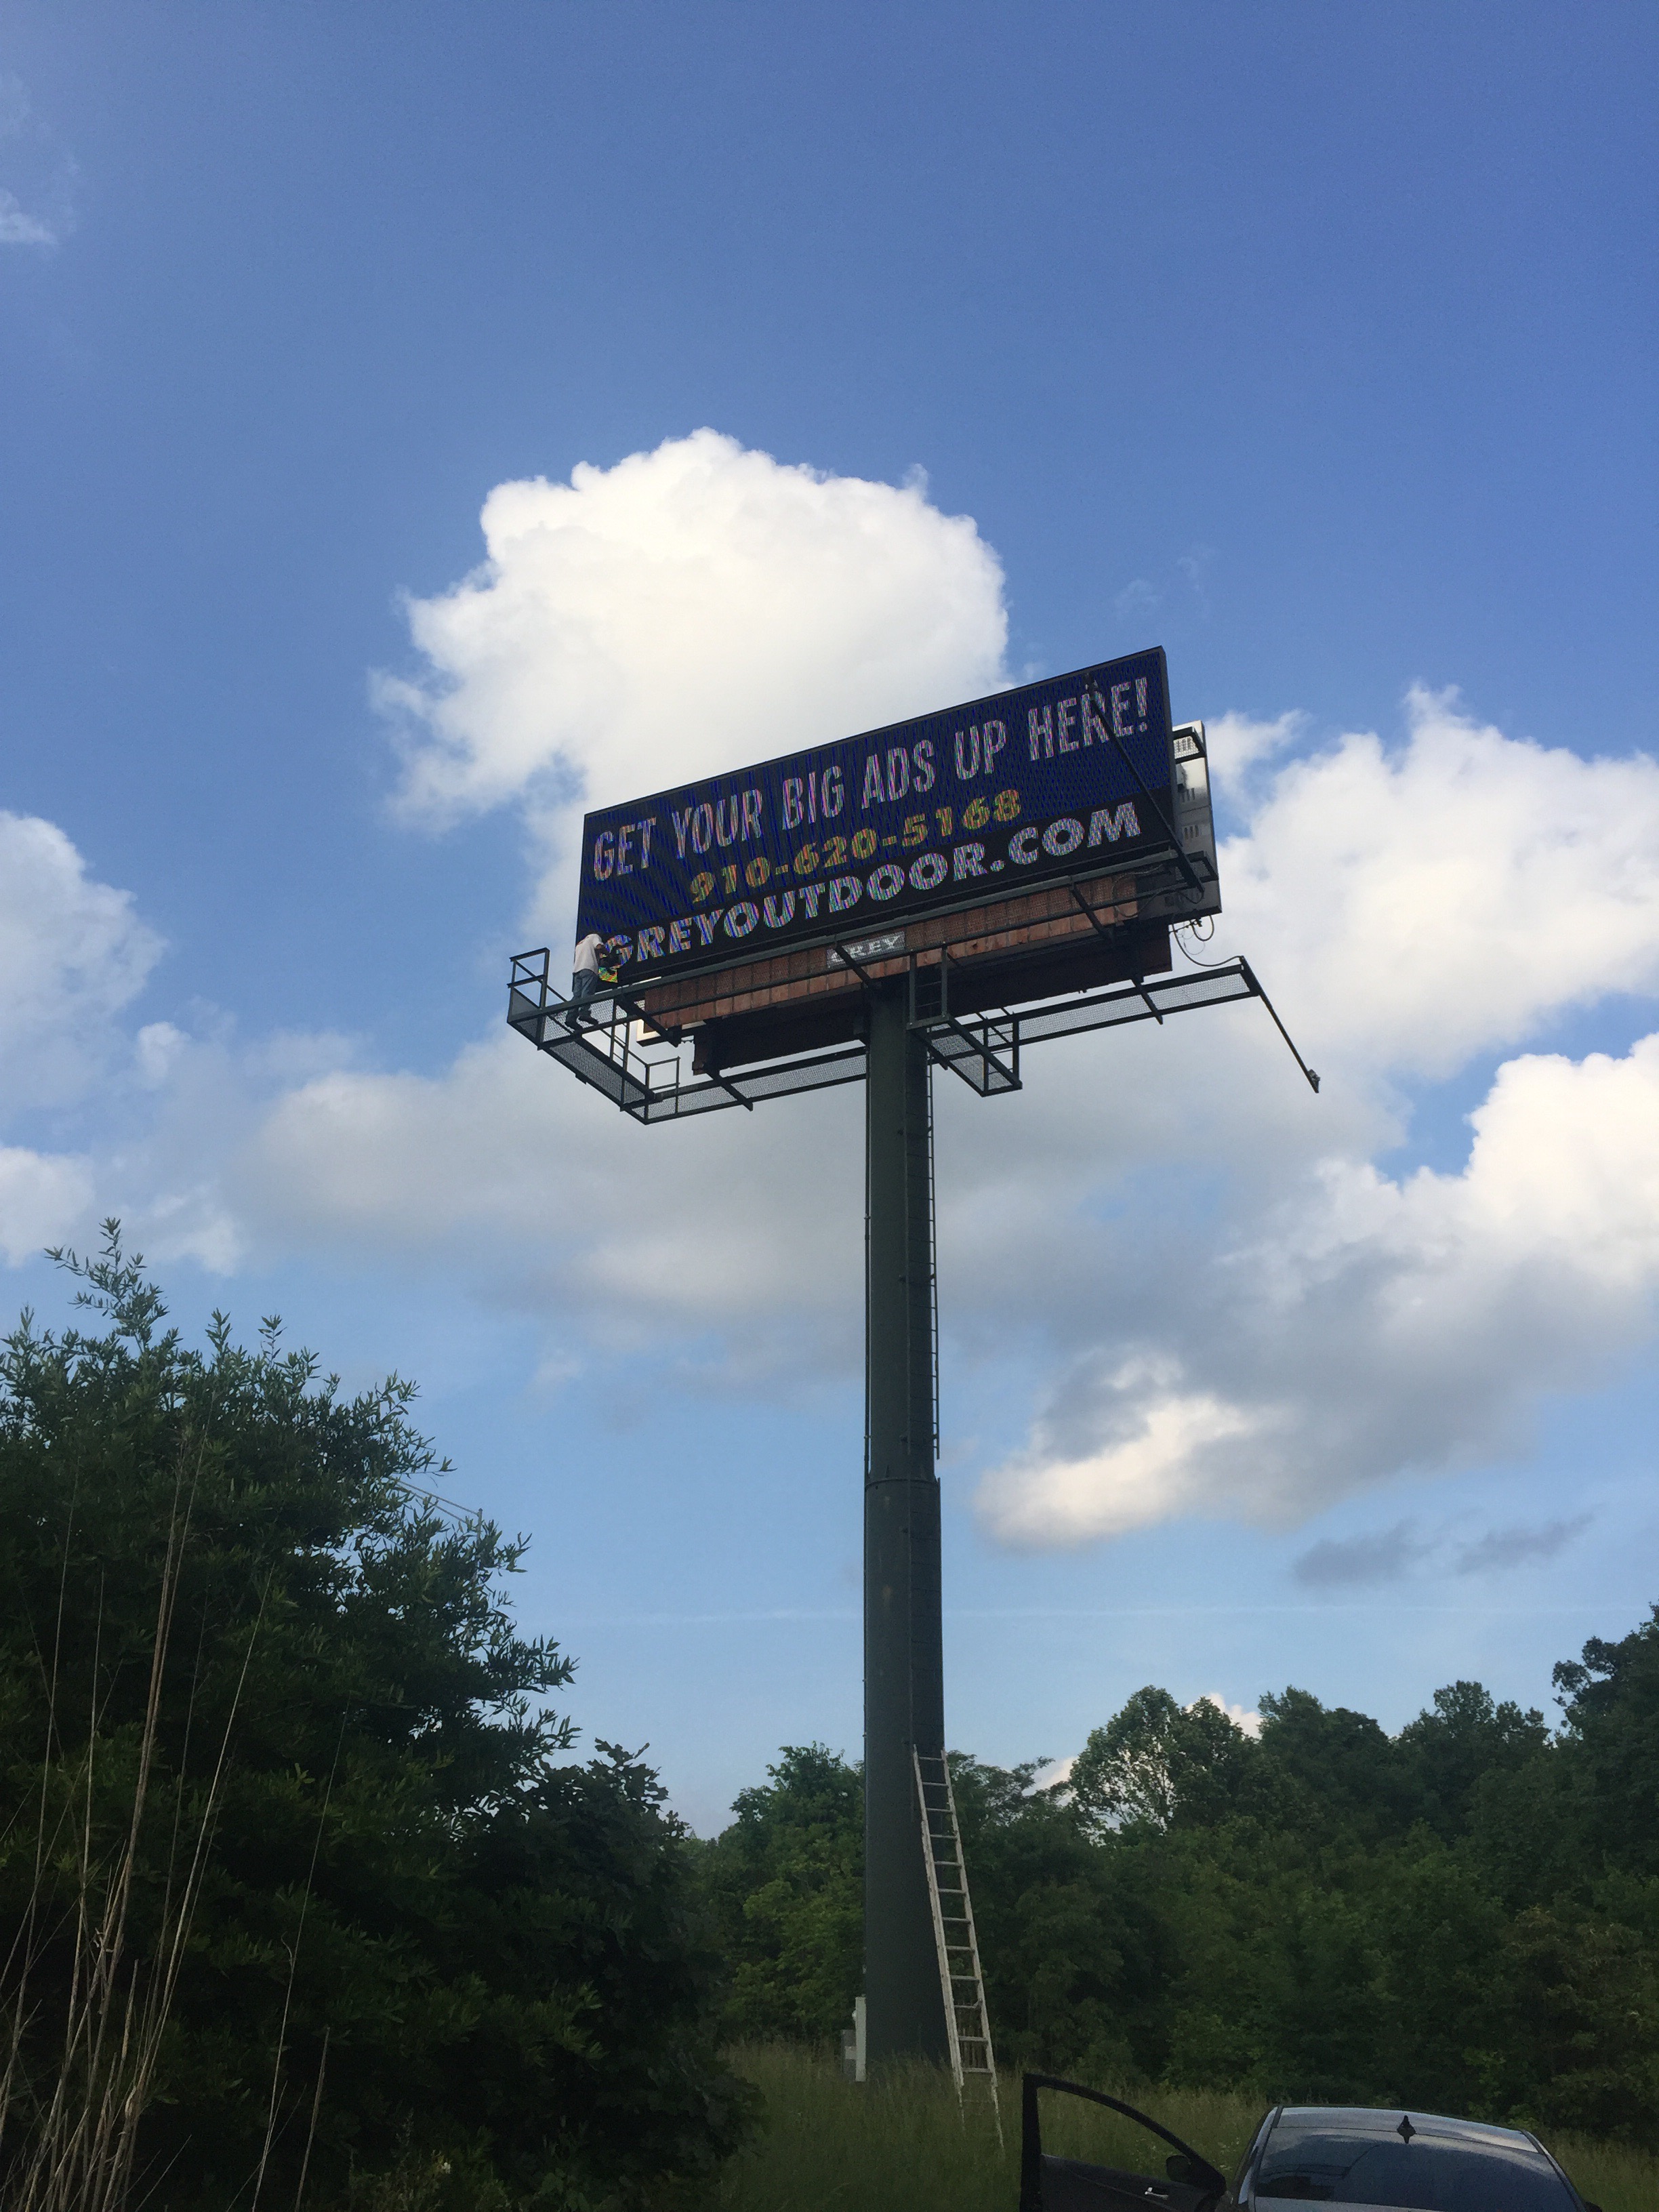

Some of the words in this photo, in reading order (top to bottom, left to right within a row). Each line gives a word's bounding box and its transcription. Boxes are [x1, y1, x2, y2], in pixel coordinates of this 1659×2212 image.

[594, 817, 656, 881] GET
[672, 790, 762, 859] YOUR
[783, 765, 844, 830] BIG
[861, 739, 936, 809] ADS
[955, 720, 1006, 781] UP
[1028, 677, 1148, 761] HERE!
[691, 789, 1021, 903] 910-620-5168
[602, 802, 1141, 969] GREYOUTDOOR.COM
